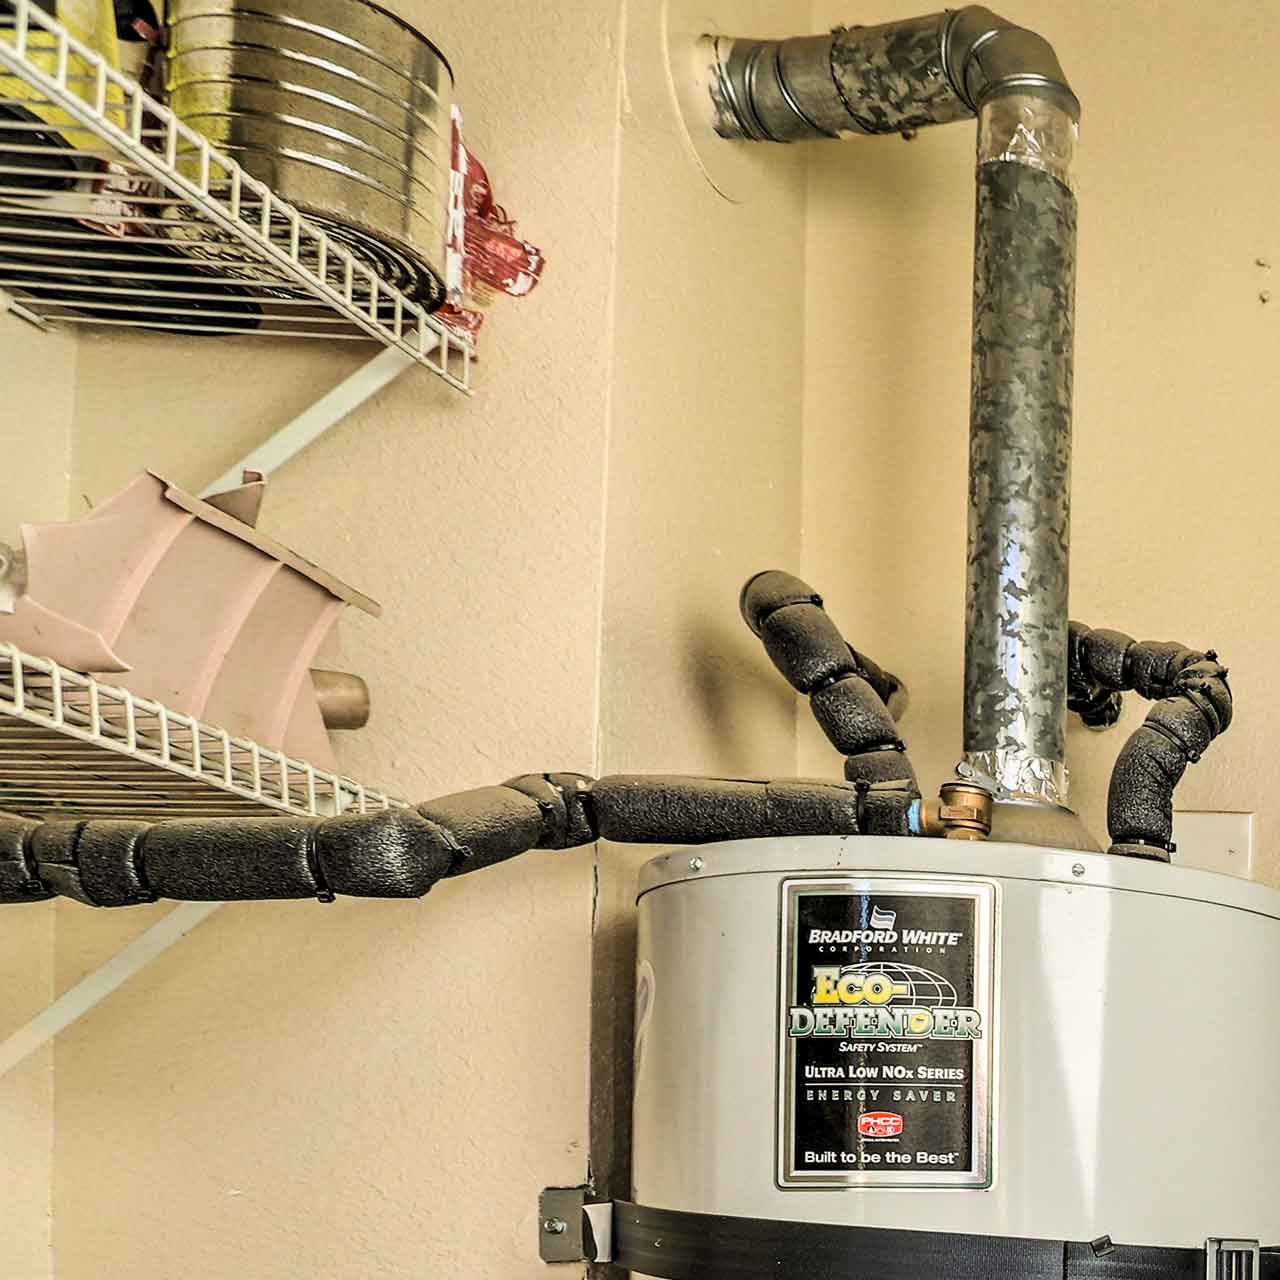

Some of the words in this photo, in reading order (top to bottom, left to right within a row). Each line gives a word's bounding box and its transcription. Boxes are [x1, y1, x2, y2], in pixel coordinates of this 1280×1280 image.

[809, 930, 898, 944] BRADFORD
[789, 1005, 982, 1037] DEFENDER
[839, 1042, 876, 1052] SAFETY
[805, 1067, 844, 1078] ULTRA
[849, 1067, 878, 1078] LOW
[917, 1067, 963, 1079] SERIES
[806, 1090, 879, 1101] ENERGY
[893, 1091, 956, 1102] SAVER
[862, 1117, 899, 1125] PHCC
[804, 1152, 836, 1163] Built
[840, 1153, 856, 1163] to
[861, 1152, 881, 1163] be
[885, 1152, 911, 1163] the
